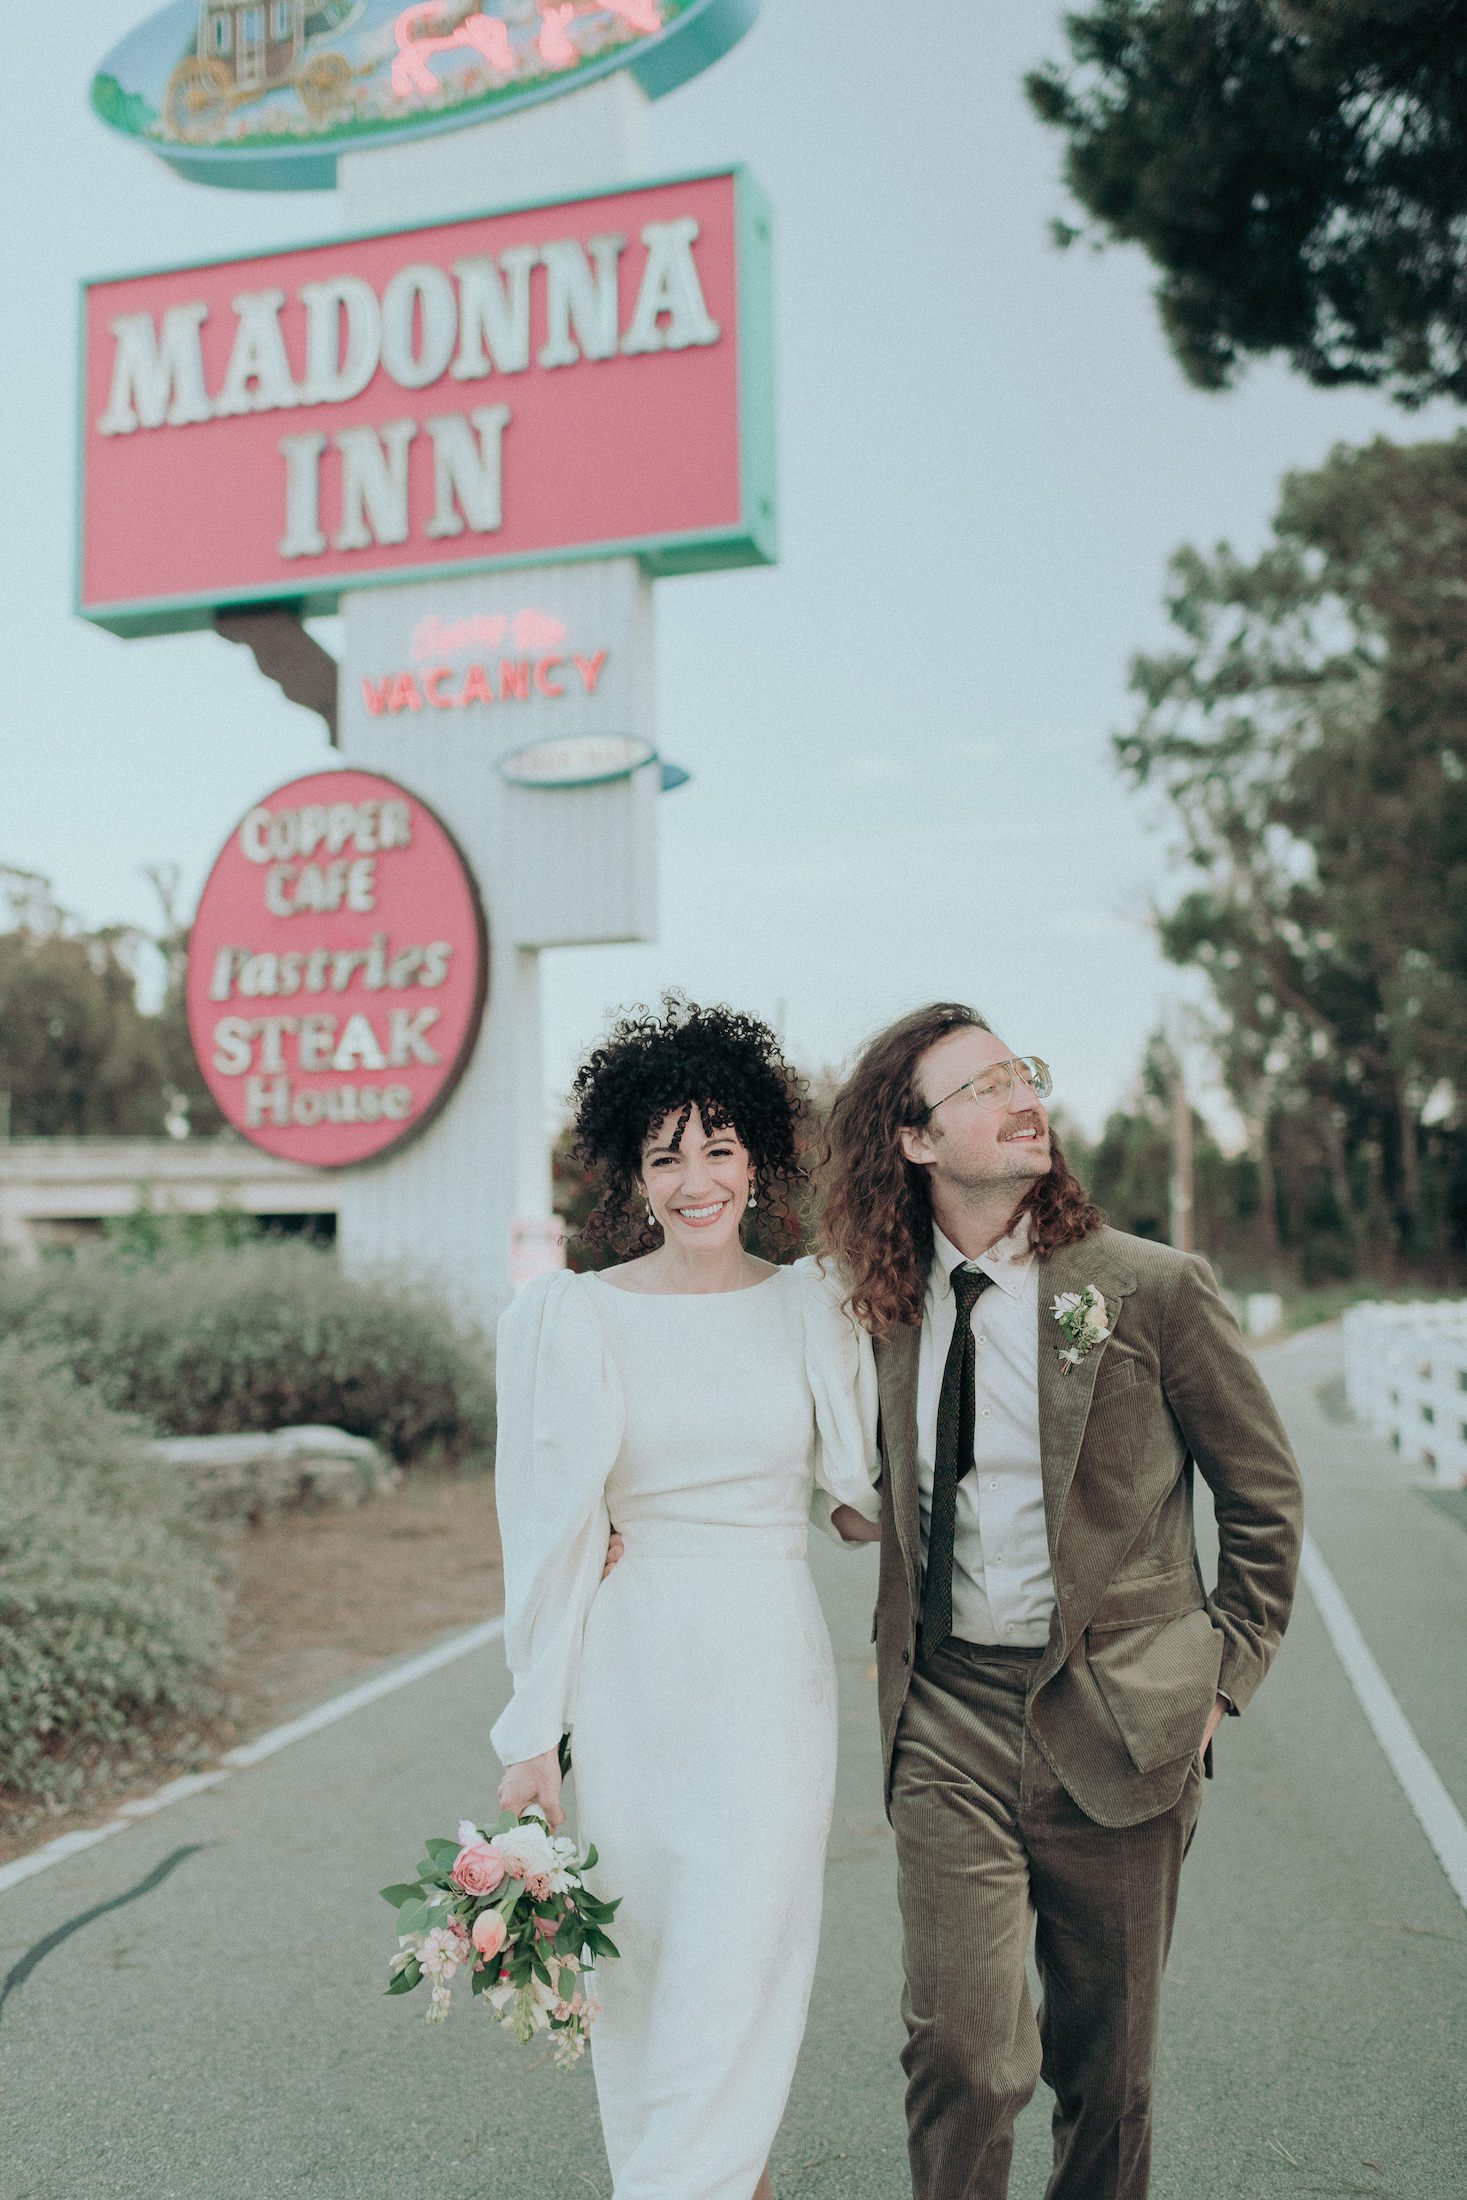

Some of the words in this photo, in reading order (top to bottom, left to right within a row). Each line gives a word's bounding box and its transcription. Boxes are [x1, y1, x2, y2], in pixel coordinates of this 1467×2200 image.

[98, 217, 720, 436] MADONNA
[278, 403, 511, 559] INN
[361, 647, 608, 717] VACANCY
[240, 799, 413, 863] COPPER
[265, 857, 378, 917] CAFE
[209, 931, 453, 1002] Pastries
[212, 1006, 441, 1077] STEAK
[244, 1074, 414, 1128] House
